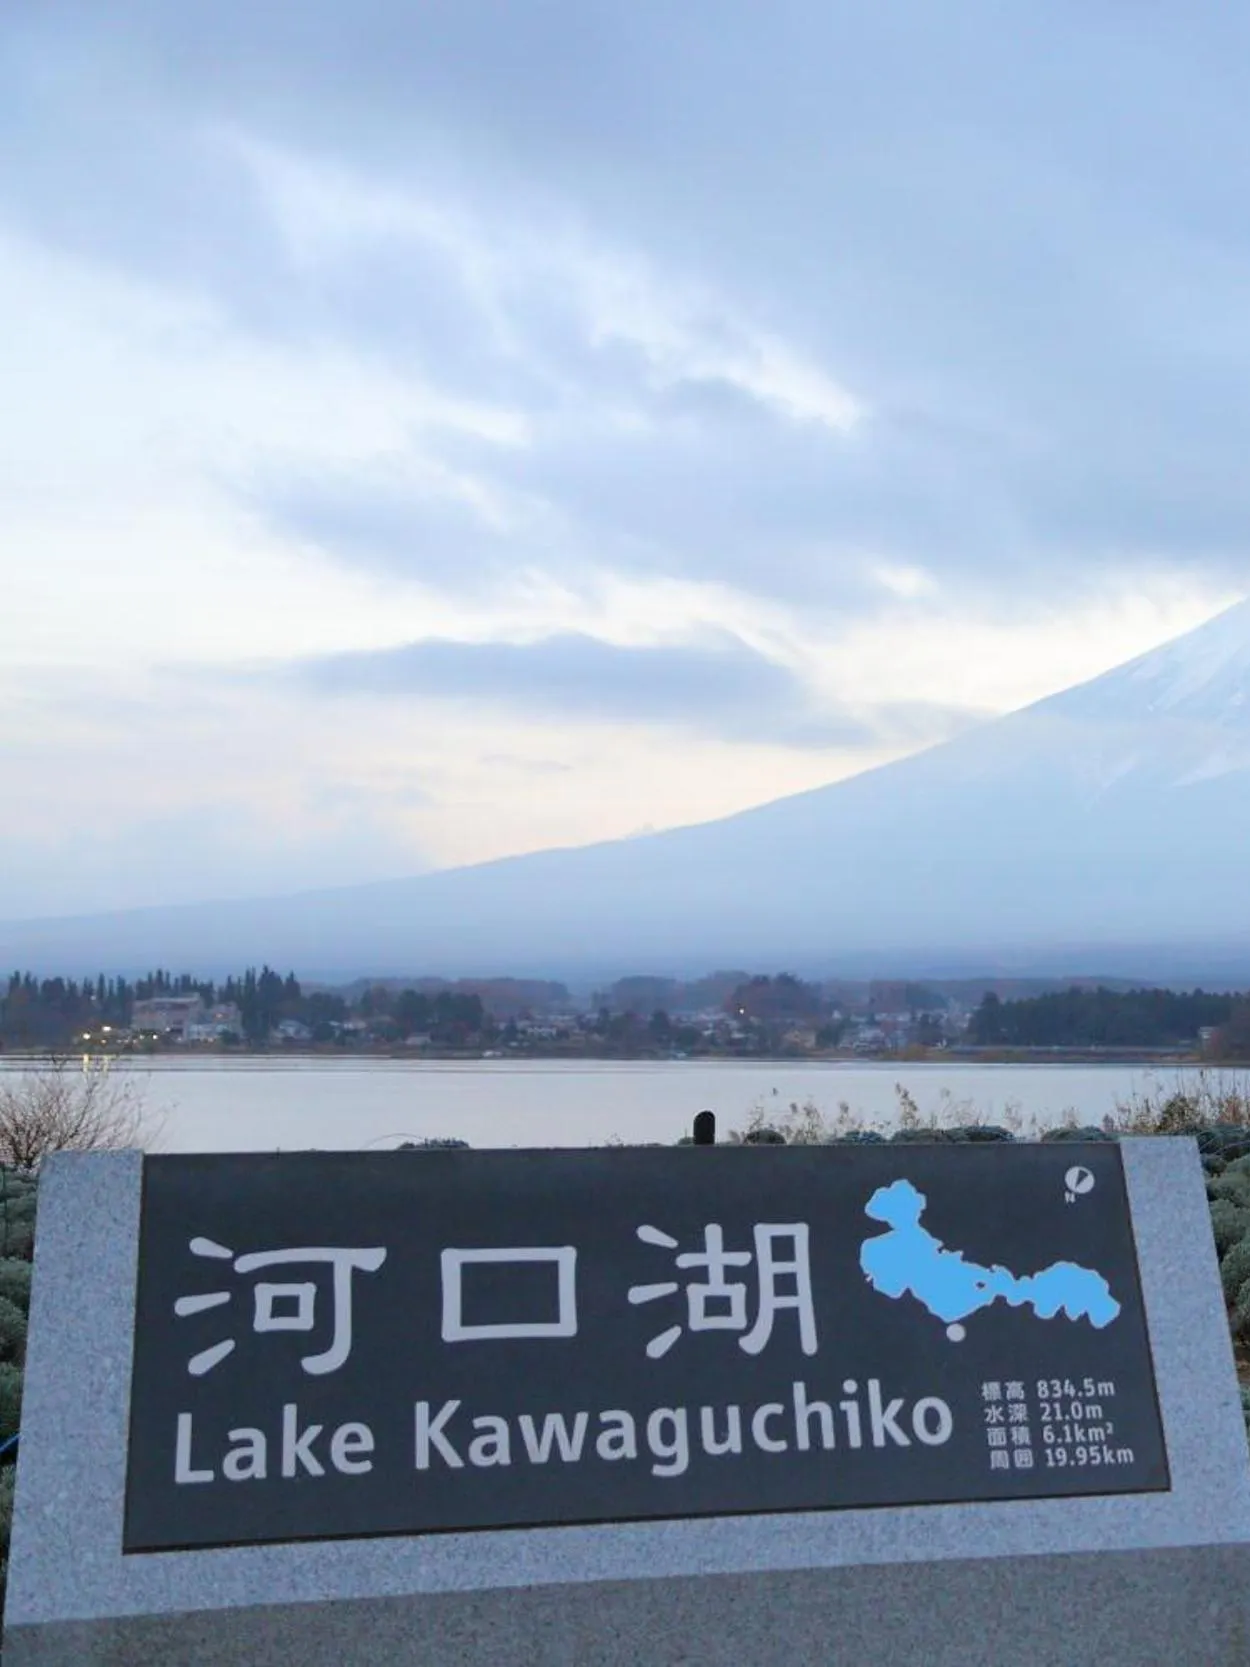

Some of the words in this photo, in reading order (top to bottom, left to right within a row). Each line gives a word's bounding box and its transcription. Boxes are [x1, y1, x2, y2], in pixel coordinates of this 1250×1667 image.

[174, 1222, 819, 1375] 河口湖
[1036, 1377, 1116, 1399] 834.5m
[984, 1403, 1029, 1424] 水深
[1039, 1401, 1103, 1422] 21.0m
[175, 1403, 375, 1484] Lake
[415, 1378, 954, 1476] Kawaguchiko
[986, 1425, 1031, 1447] 面積
[1045, 1444, 1135, 1468] 19.95km
